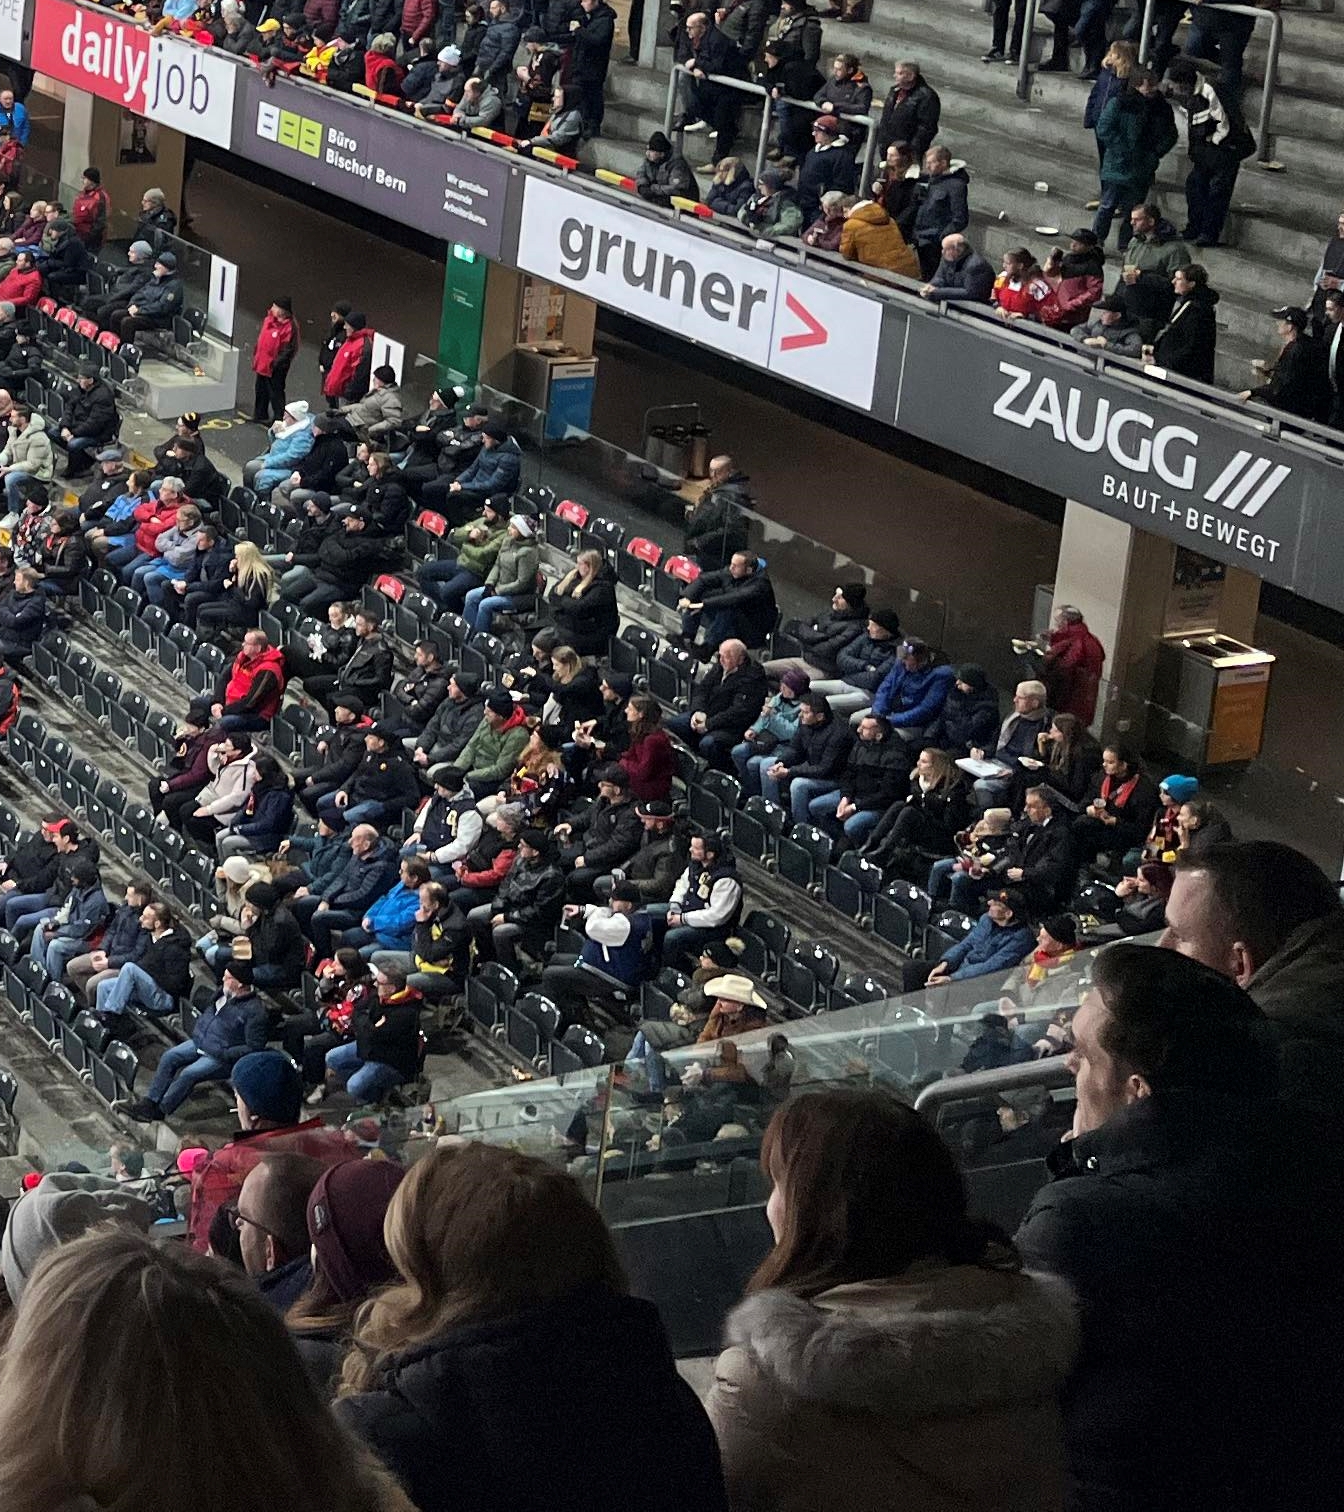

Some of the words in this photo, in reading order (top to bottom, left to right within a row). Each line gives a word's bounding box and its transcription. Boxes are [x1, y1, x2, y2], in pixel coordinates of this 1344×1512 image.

[325, 147, 373, 182] Bischof
[375, 166, 408, 195] Bern
[326, 125, 358, 153] Büro
[559, 216, 767, 333] gruner
[991, 360, 1200, 492] ZAUGG
[1101, 473, 1283, 565] BAUT+BEWEGT
